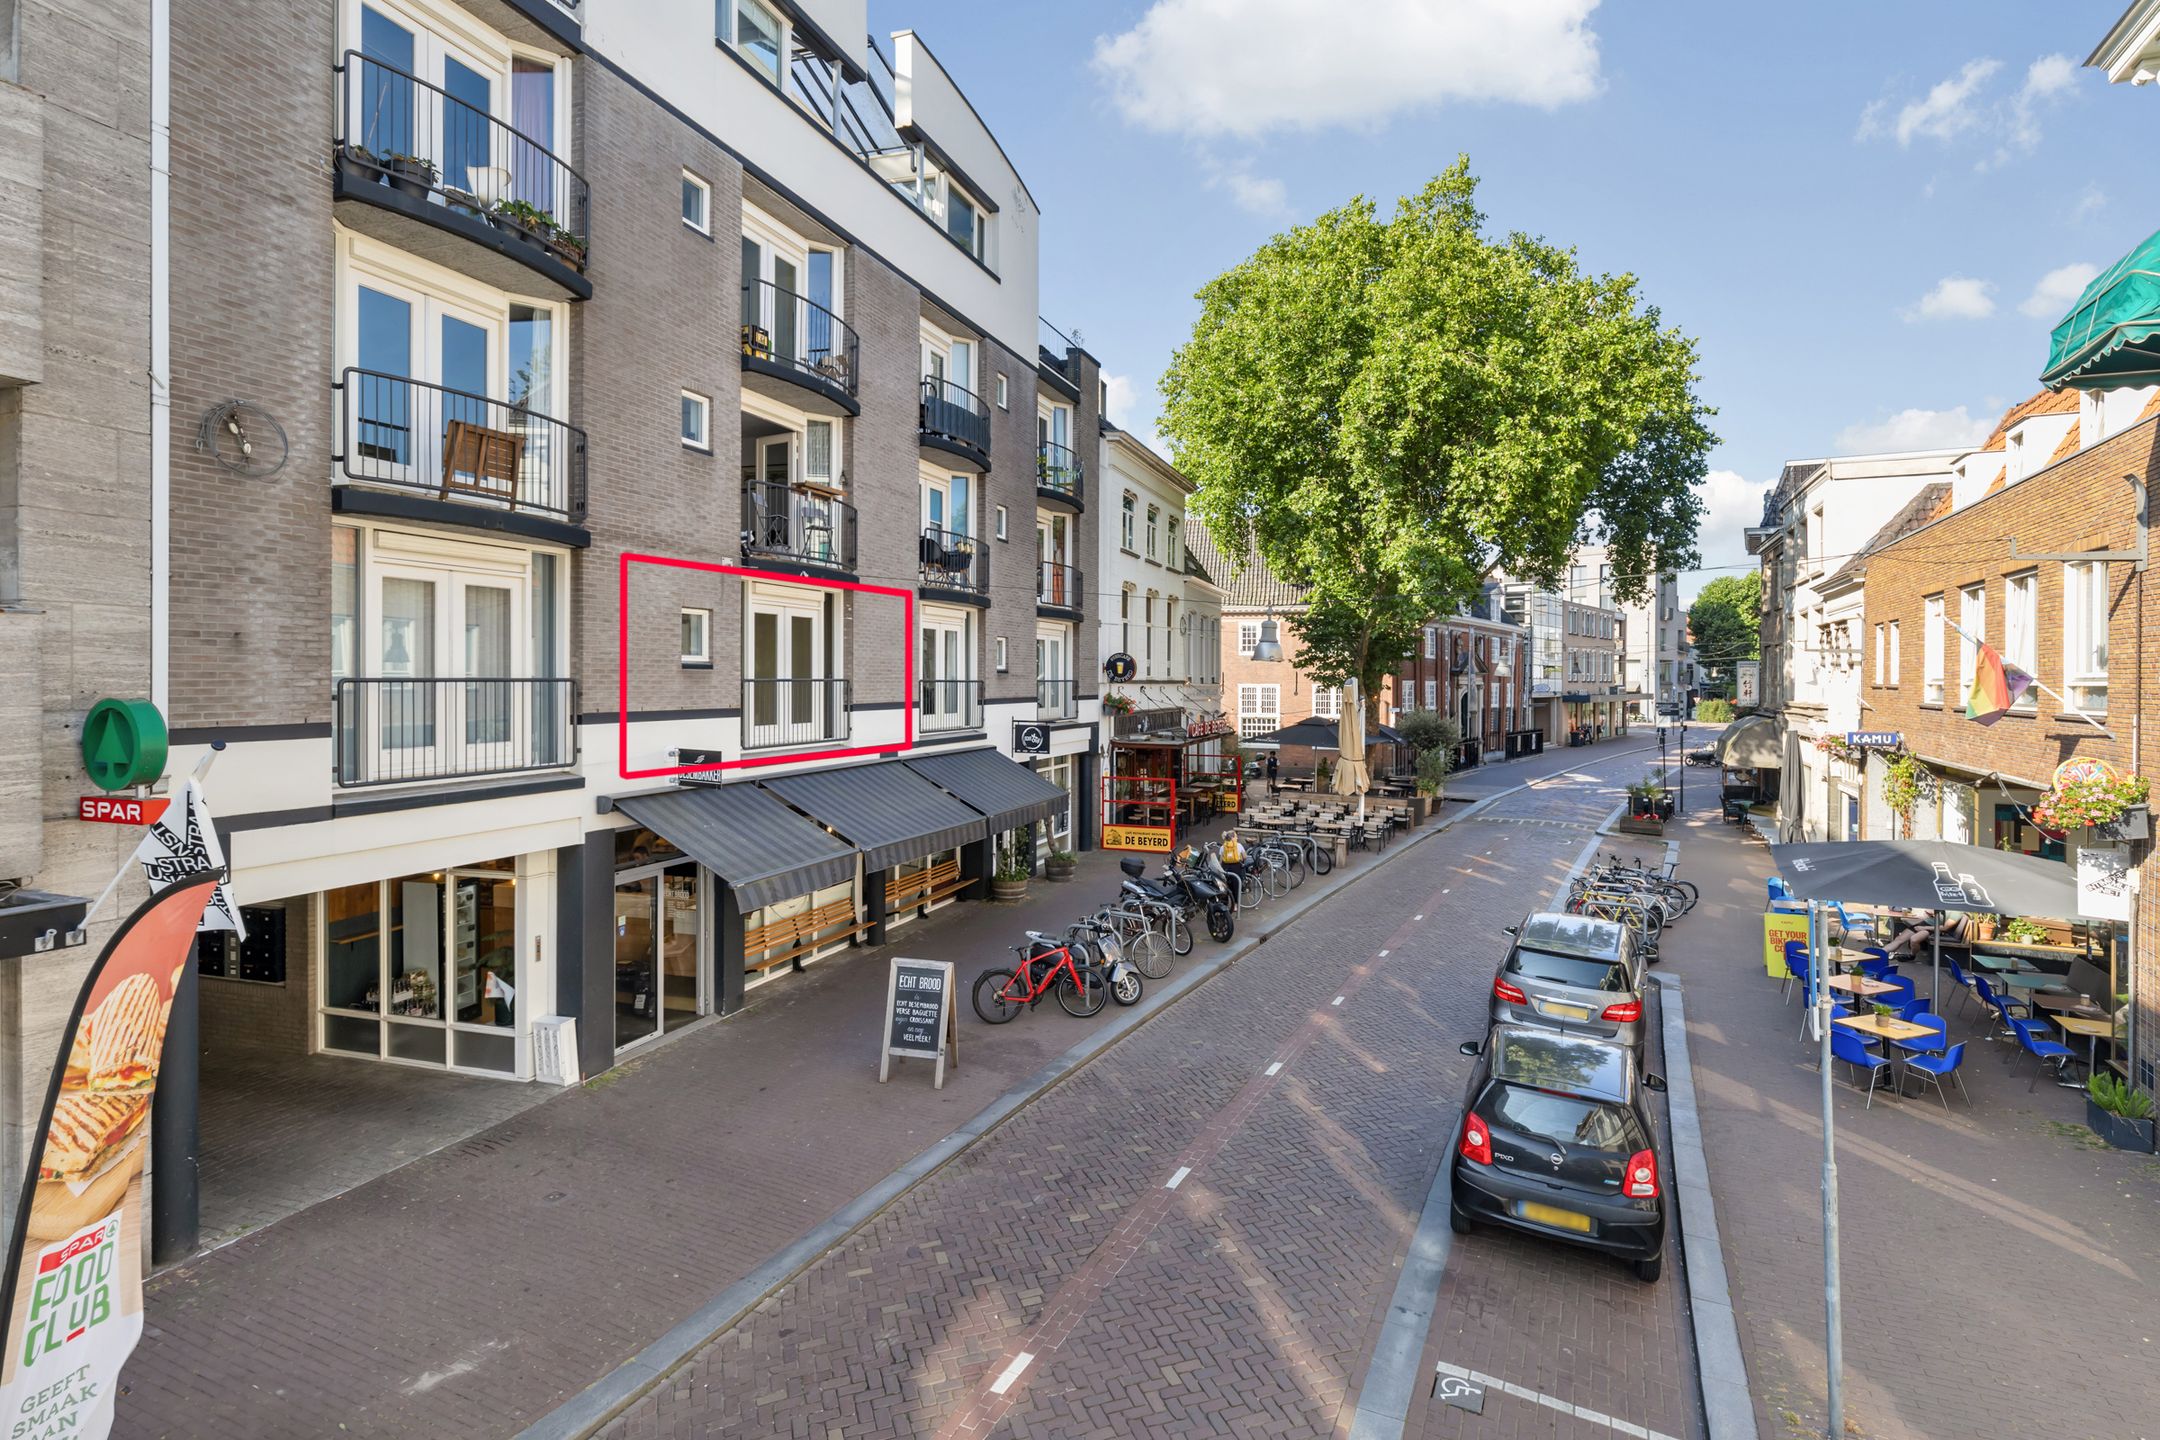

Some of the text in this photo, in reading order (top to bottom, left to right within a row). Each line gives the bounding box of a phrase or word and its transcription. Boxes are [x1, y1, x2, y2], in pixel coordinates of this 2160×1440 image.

[1853, 734, 1891, 744] KAMU
[82, 801, 141, 821] SPAR
[1125, 836, 1168, 847] DE BEYERD
[157, 857, 210, 873] STRA
[1769, 929, 1807, 939] GET YOUR
[899, 975, 941, 991] ECHT BROOD
[896, 1007, 937, 1018] VERSE BAGUETTE
[908, 1001, 938, 1009] DESEMBROOD
[909, 1016, 935, 1025] CROISSANT
[1494, 1152, 1514, 1162] PIXO
[60, 1229, 105, 1263] SPAR
[30, 1241, 114, 1321] FOOD
[23, 1283, 111, 1368] CLUB
[21, 1364, 90, 1414] GEEFT
[11, 1382, 97, 1440] SMAAK
